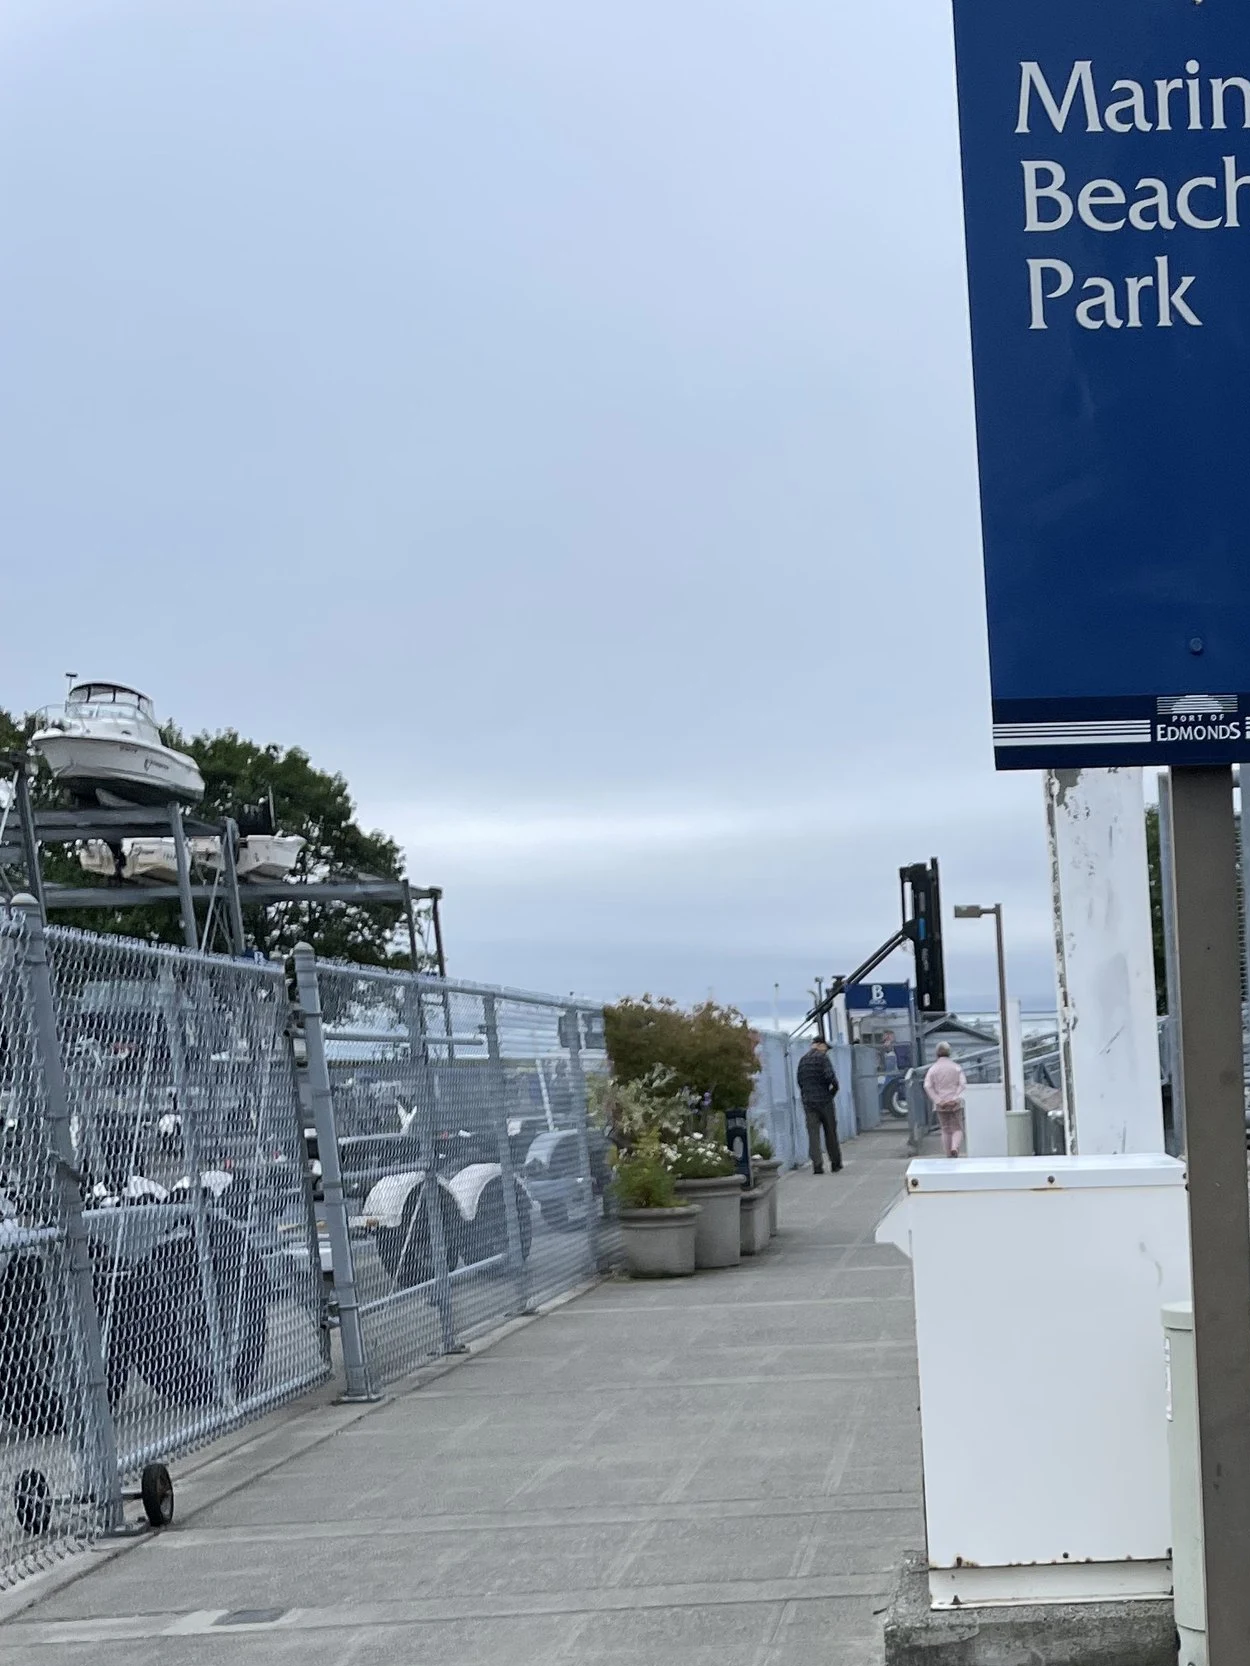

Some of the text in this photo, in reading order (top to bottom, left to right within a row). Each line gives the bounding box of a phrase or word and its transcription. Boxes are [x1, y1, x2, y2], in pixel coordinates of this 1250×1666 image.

[1026, 255, 1203, 330] Park
[1172, 713, 1225, 722] PORT OF
[1156, 721, 1242, 742] EDMONDS
[871, 984, 885, 1000] B
